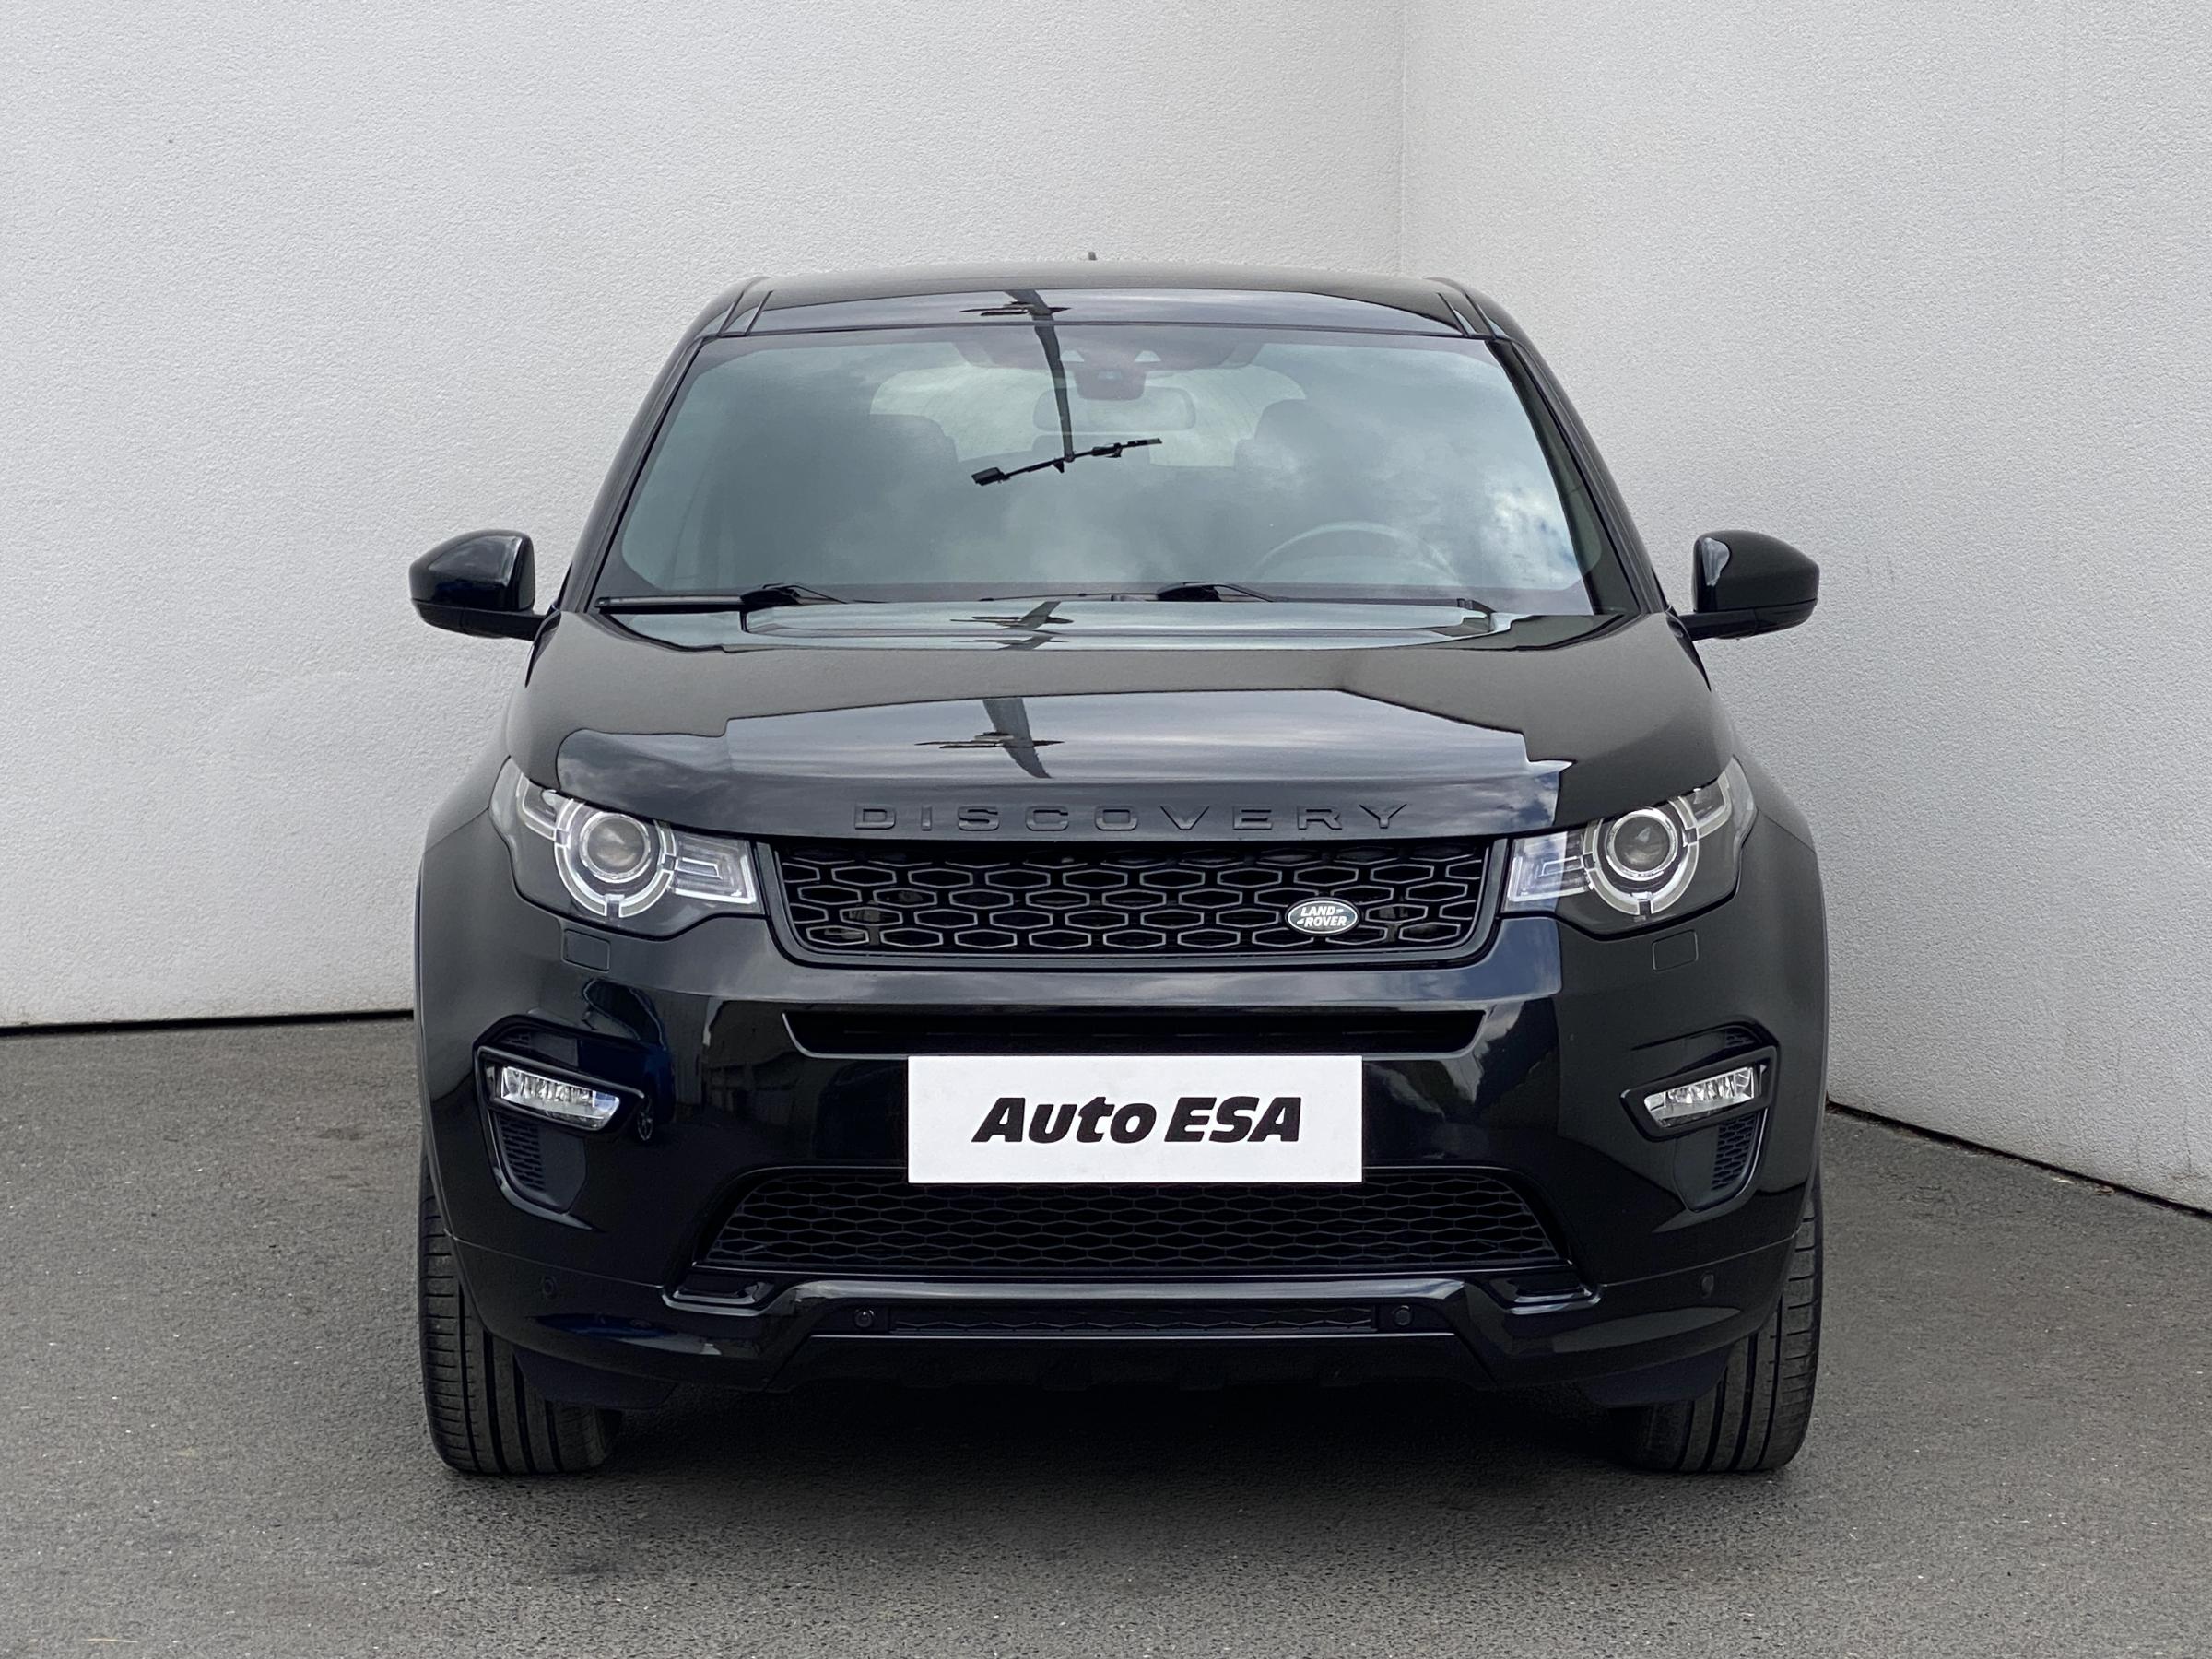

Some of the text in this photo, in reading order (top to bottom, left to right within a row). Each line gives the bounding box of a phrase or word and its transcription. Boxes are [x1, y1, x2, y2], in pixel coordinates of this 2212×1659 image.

[853, 803, 1407, 831] DISCOVERY
[1300, 905, 1336, 917] LAND
[1303, 915, 1347, 927] ROVER
[971, 1096, 1302, 1144] Auto ESA
